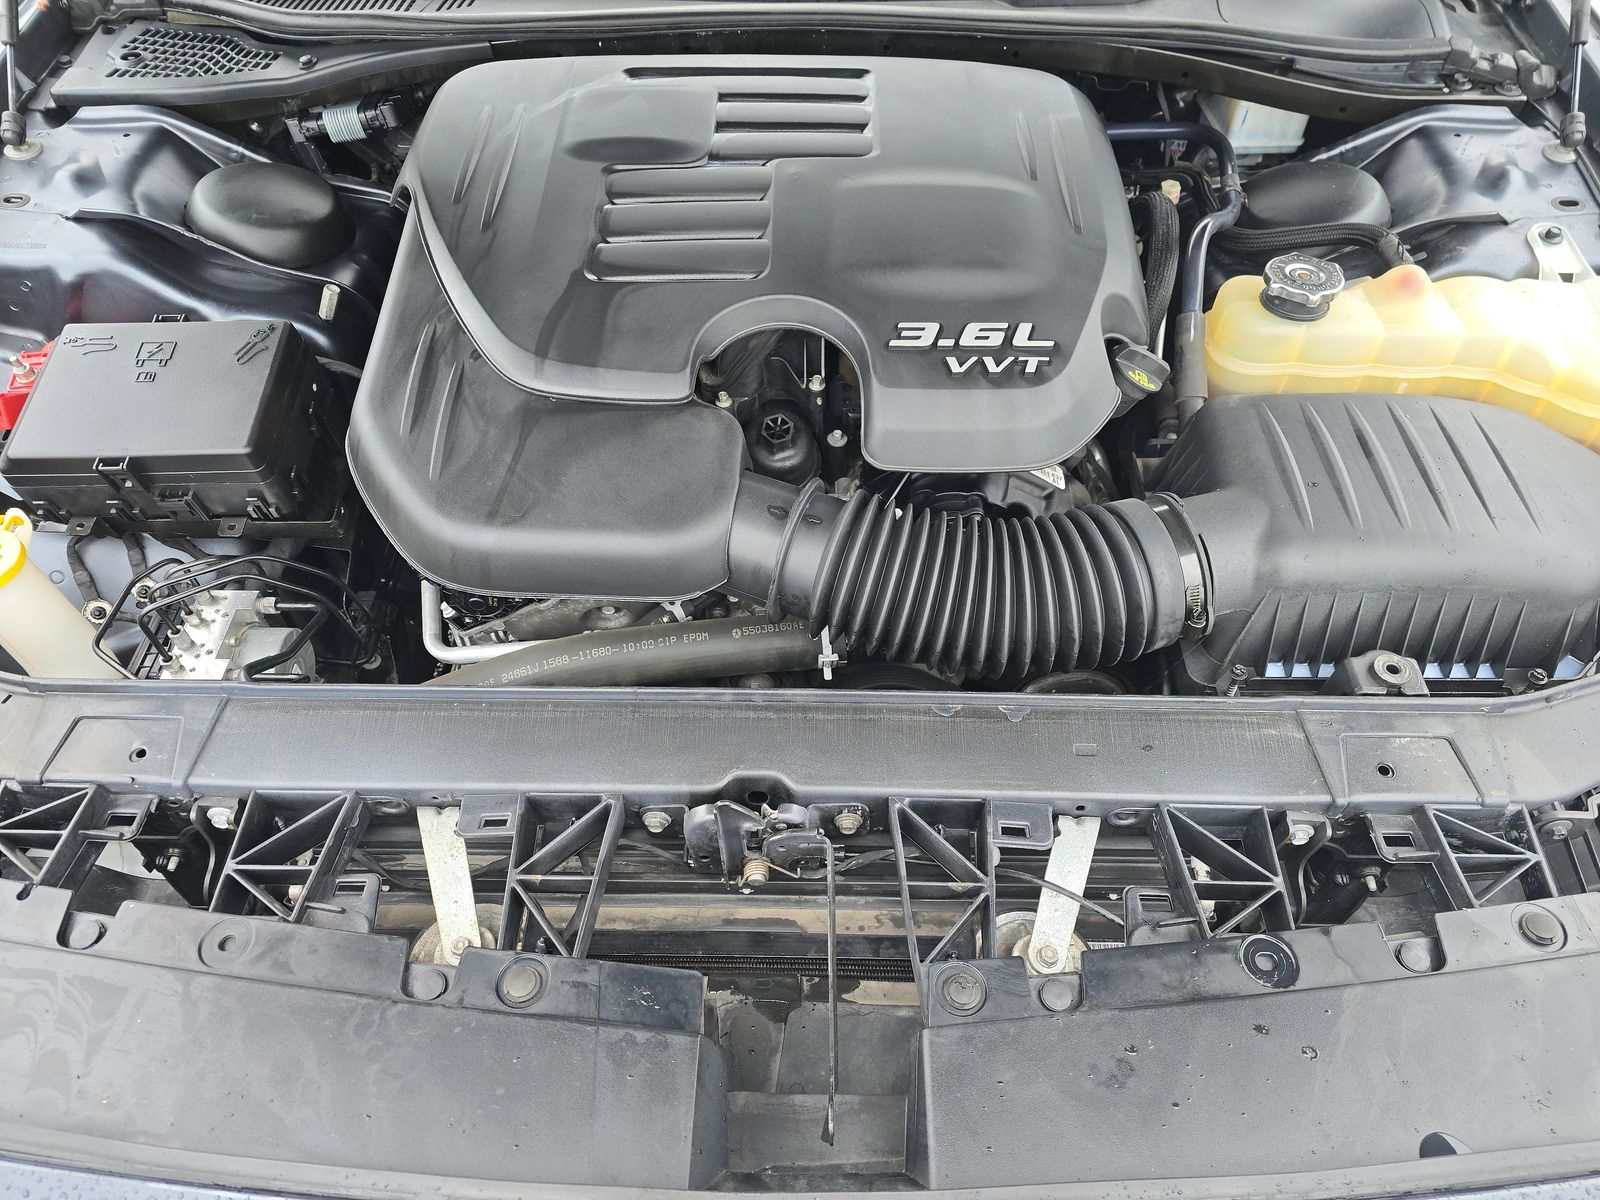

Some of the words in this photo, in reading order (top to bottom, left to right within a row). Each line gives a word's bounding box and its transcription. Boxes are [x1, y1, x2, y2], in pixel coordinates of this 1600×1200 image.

[888, 322, 1055, 348] 3.6L
[945, 356, 1050, 376] VVT
[683, 632, 709, 643] EPDM
